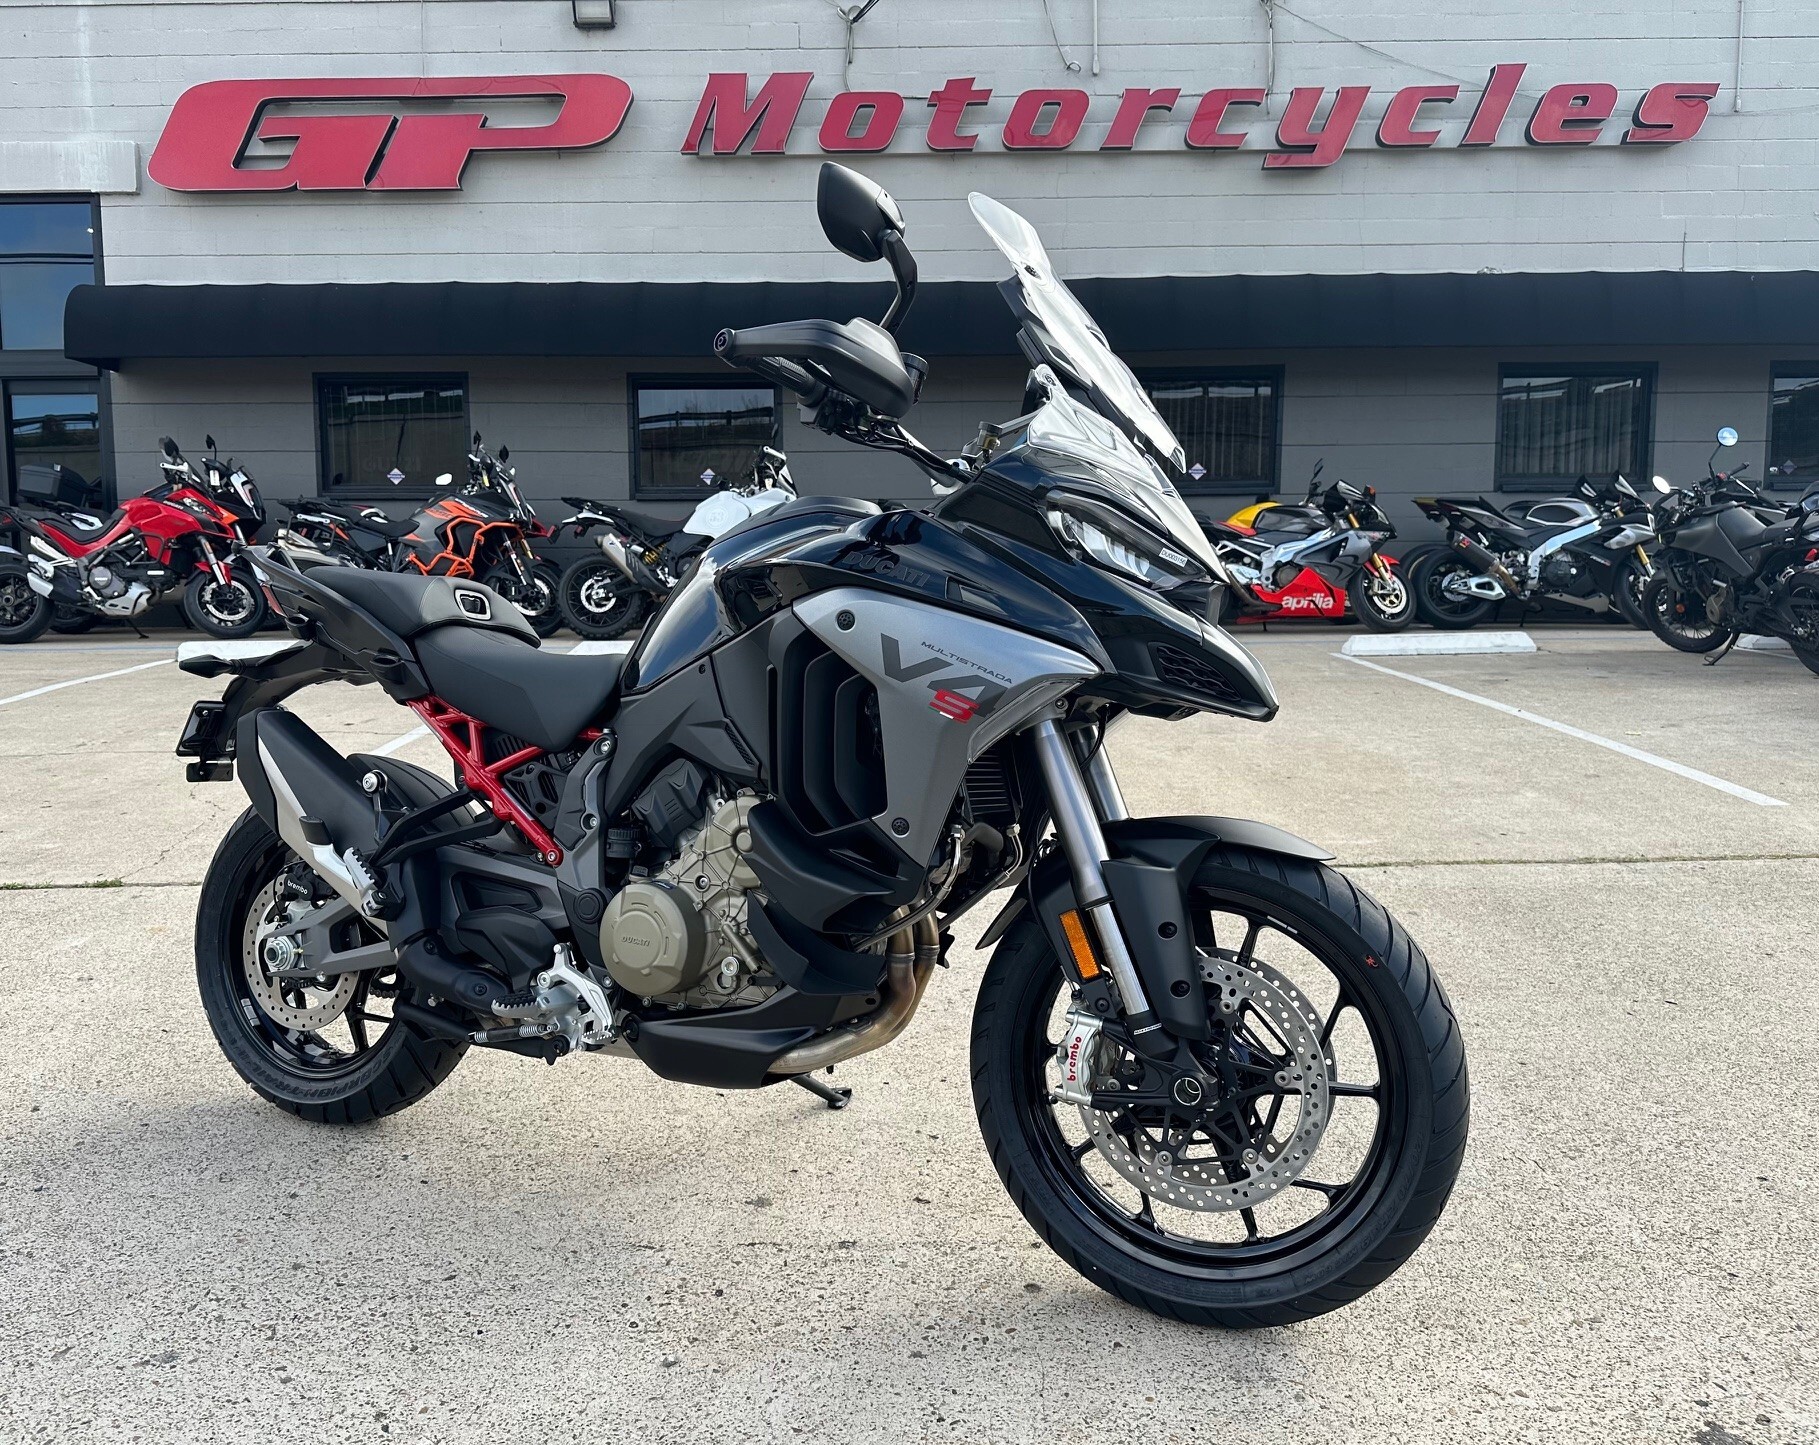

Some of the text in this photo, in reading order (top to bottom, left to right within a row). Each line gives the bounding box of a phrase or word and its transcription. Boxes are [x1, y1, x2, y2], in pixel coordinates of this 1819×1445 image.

[147, 63, 1720, 192] GP Motorcycles
[842, 550, 931, 588] DUCATI
[1282, 593, 1335, 611] aprilia
[921, 641, 1014, 685] MULTISTRADA
[287, 880, 308, 895] brembo
[622, 936, 651, 947] DUCATI
[1066, 1036, 1083, 1082] brembo
